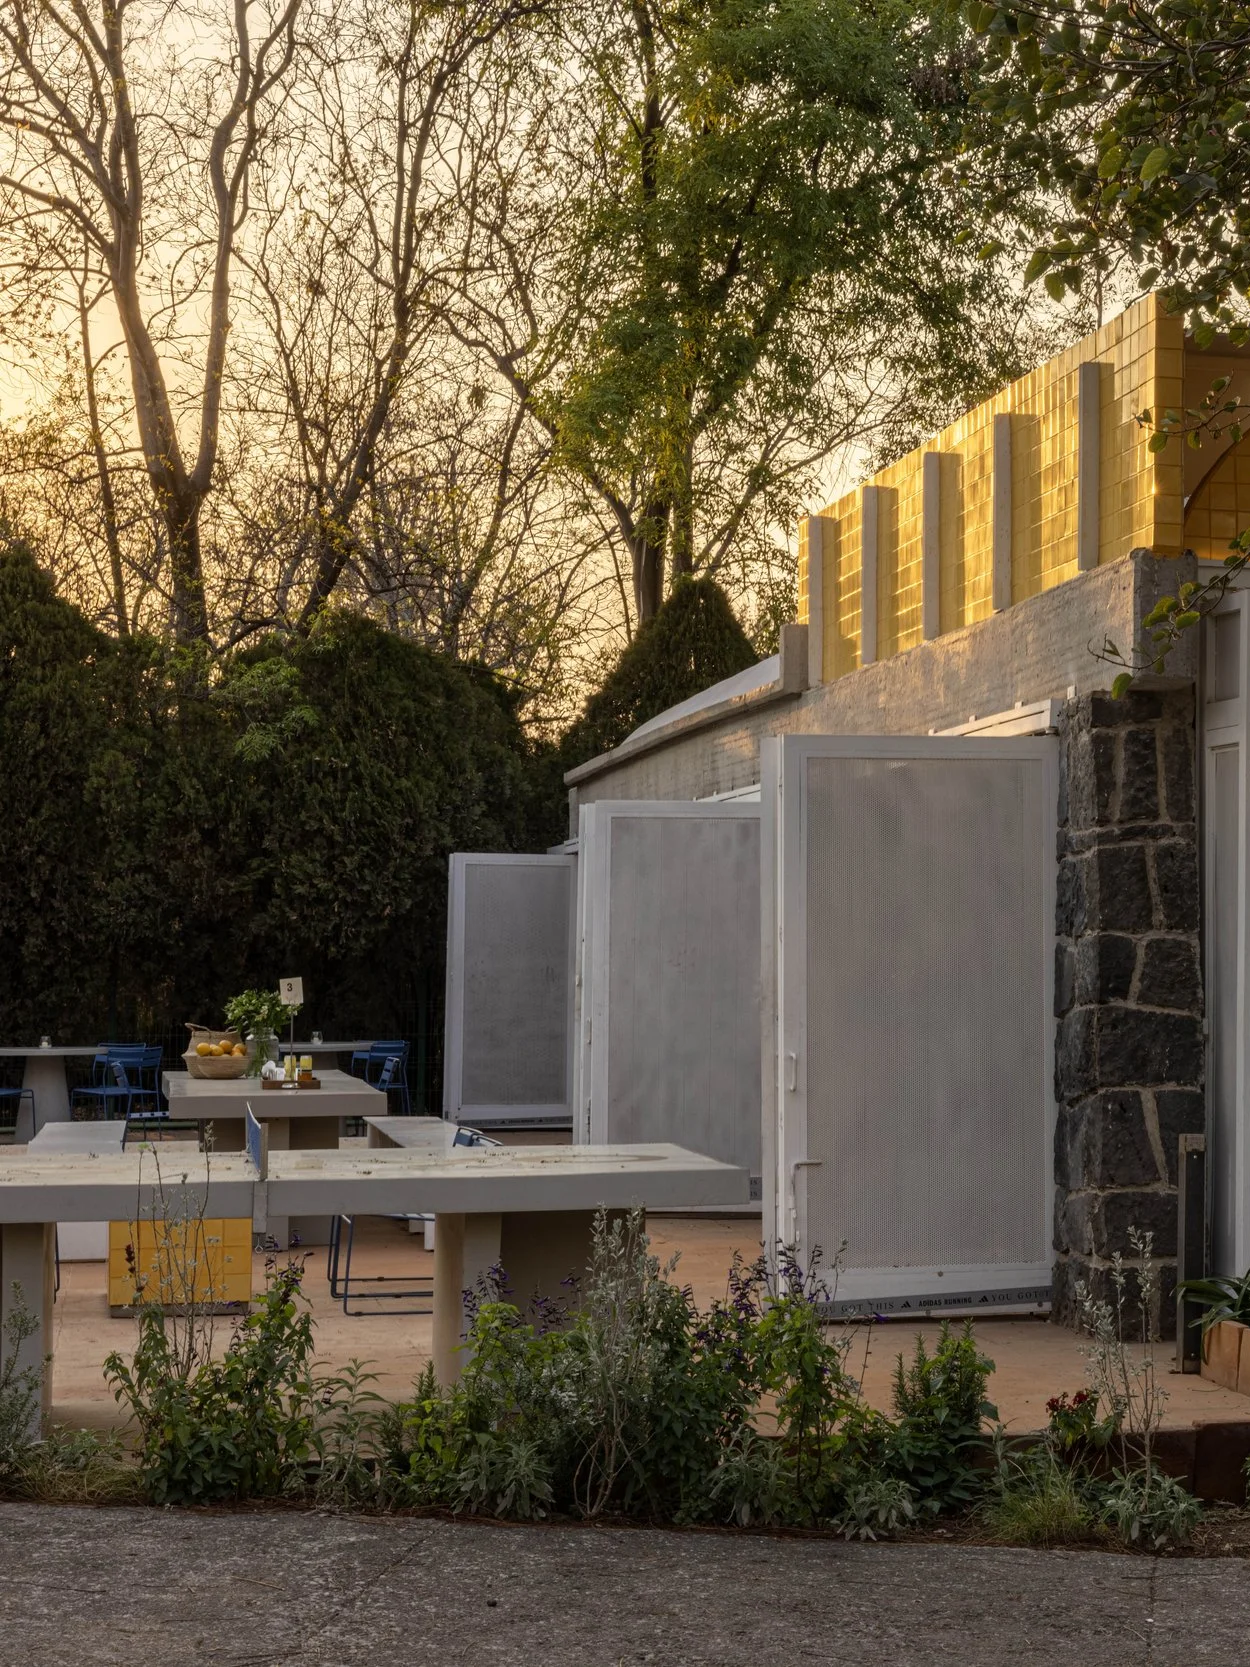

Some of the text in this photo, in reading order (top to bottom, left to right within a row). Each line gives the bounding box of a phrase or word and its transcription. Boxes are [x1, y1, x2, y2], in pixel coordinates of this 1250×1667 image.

[287, 983, 293, 992] 3
[841, 1303, 864, 1313] GOT
[918, 1298, 942, 1307] ADIDAS
[944, 1296, 972, 1305] RUNNING
[991, 1293, 1012, 1302] YOU
